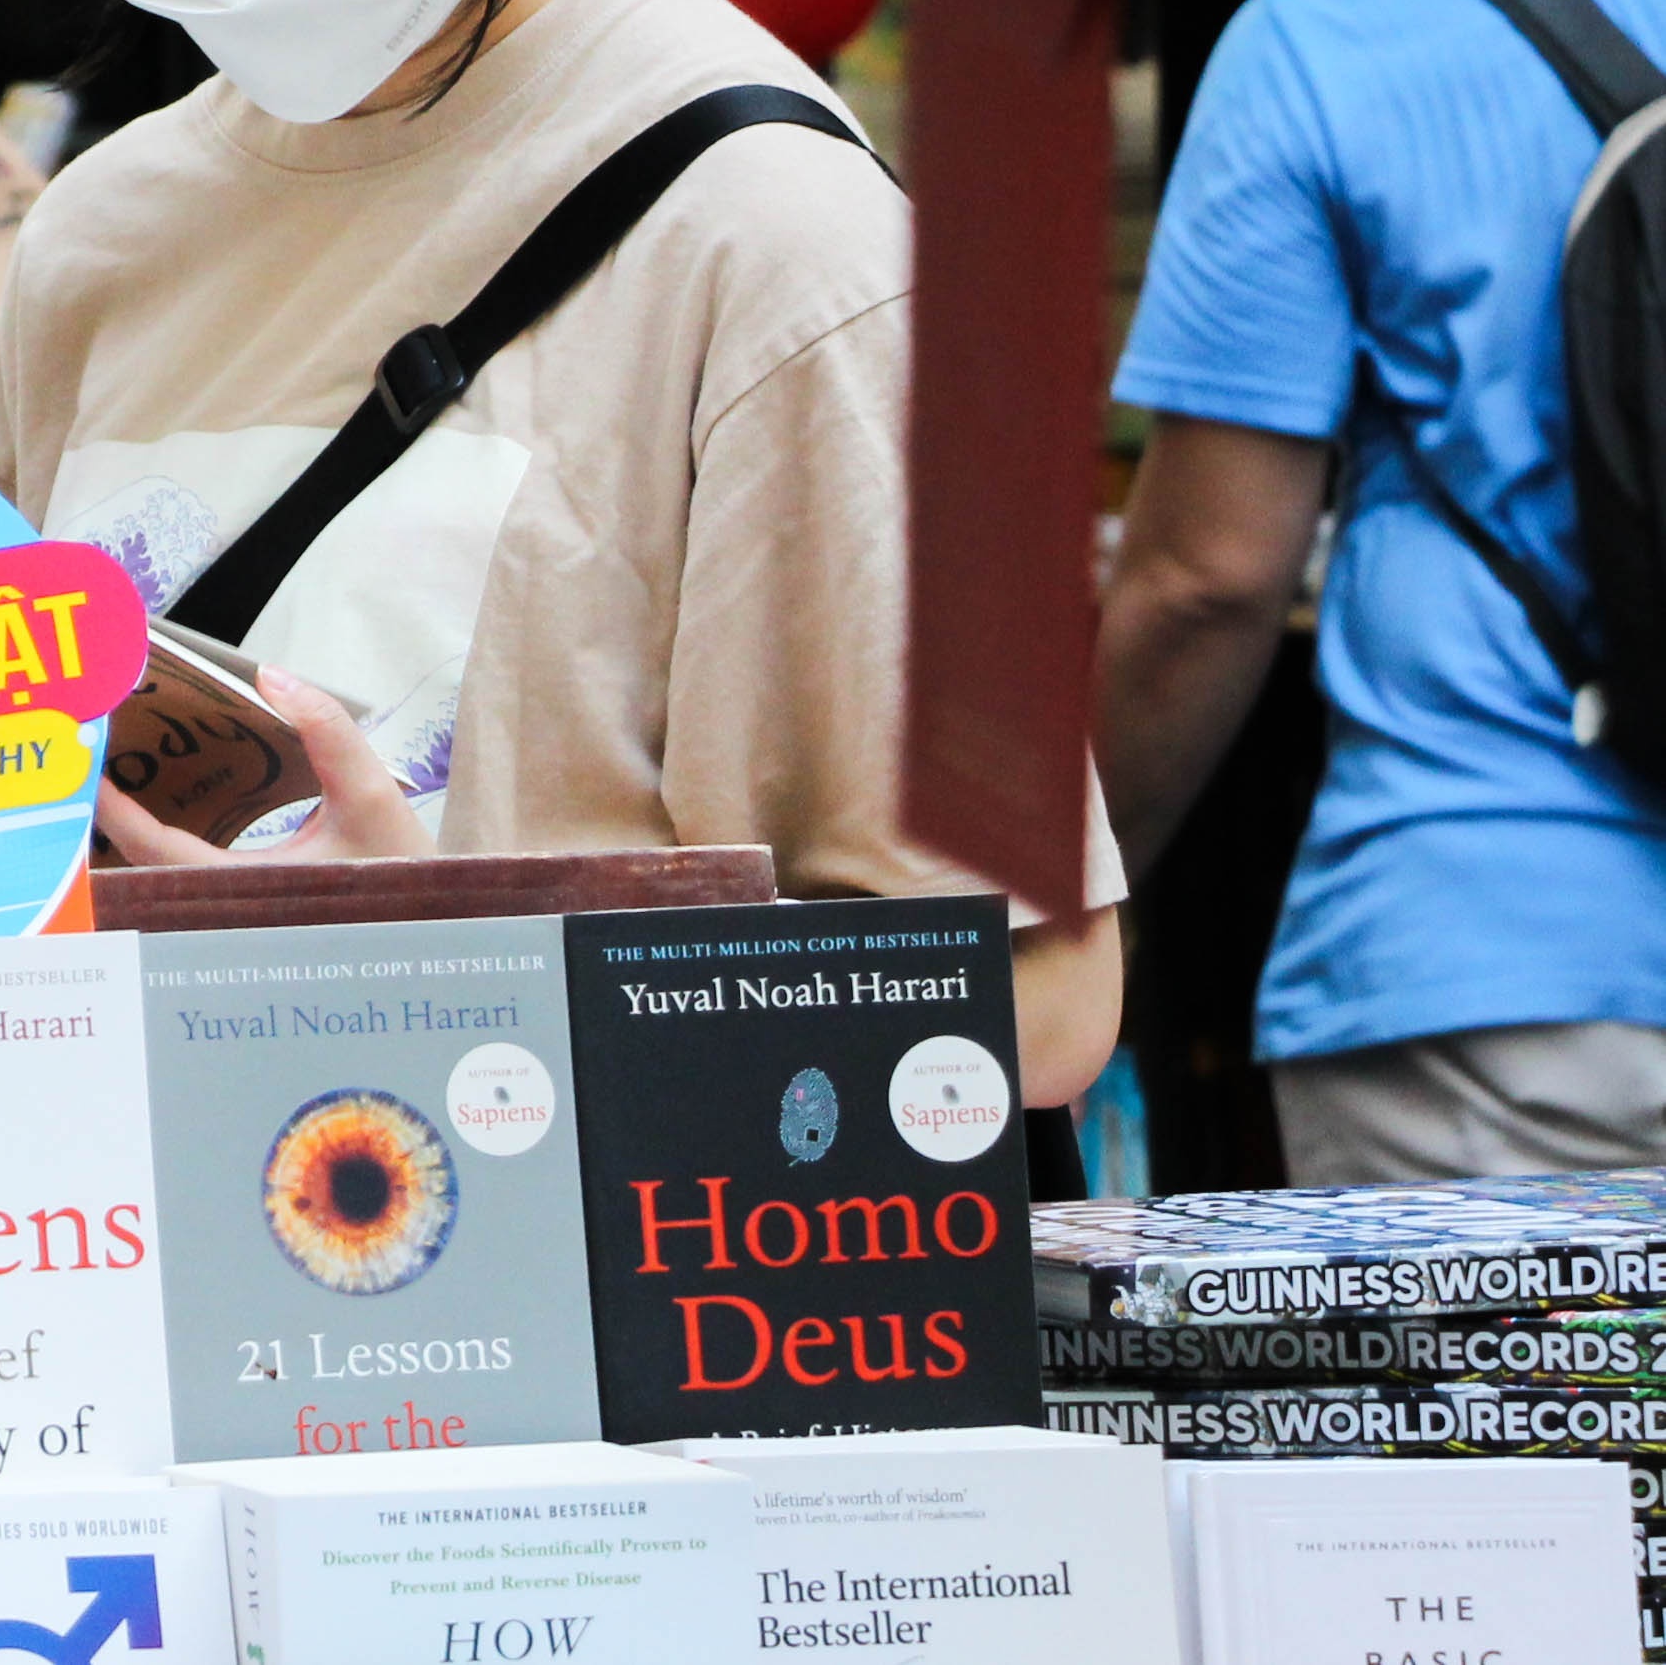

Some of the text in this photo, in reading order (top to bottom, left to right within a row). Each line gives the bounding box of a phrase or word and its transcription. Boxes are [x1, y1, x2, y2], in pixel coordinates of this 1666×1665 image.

[603, 930, 980, 961] THE MULTI-MILLION COPY BESTSELLER
[146, 954, 545, 987] THE MULTI-MILLION COPY BESTSELLER
[621, 968, 969, 1016] Yuval Noah Harari
[177, 997, 519, 1041] Yuval Noah Harari
[458, 1101, 546, 1131] Sapiens
[902, 1102, 999, 1133] Sapiens
[630, 1177, 999, 1274] Homo
[1189, 1254, 1605, 1315] GUINNESS WORLD
[237, 1334, 511, 1382] 21 Lessons
[673, 1294, 968, 1393] Deus
[1040, 1329, 1638, 1373] INNESS WORLD RECORDS
[38, 1406, 94, 1456] of
[294, 1401, 466, 1457] for the
[1268, 1403, 1455, 1444] WORLD
[29, 1520, 69, 1539] SOLD
[76, 1517, 169, 1537] WORLDWIDE
[377, 1501, 647, 1526] THE INTERNATIONAL BESTSELLER
[322, 1534, 707, 1566] Discover the Foods Scientifically Proven to
[389, 1569, 642, 1595] Prevent and Reverse Disease
[758, 1562, 1072, 1605] The International
[1386, 1596, 1476, 1622] THE
[441, 1614, 595, 1663] HOW
[758, 1613, 932, 1650] Bestseller
